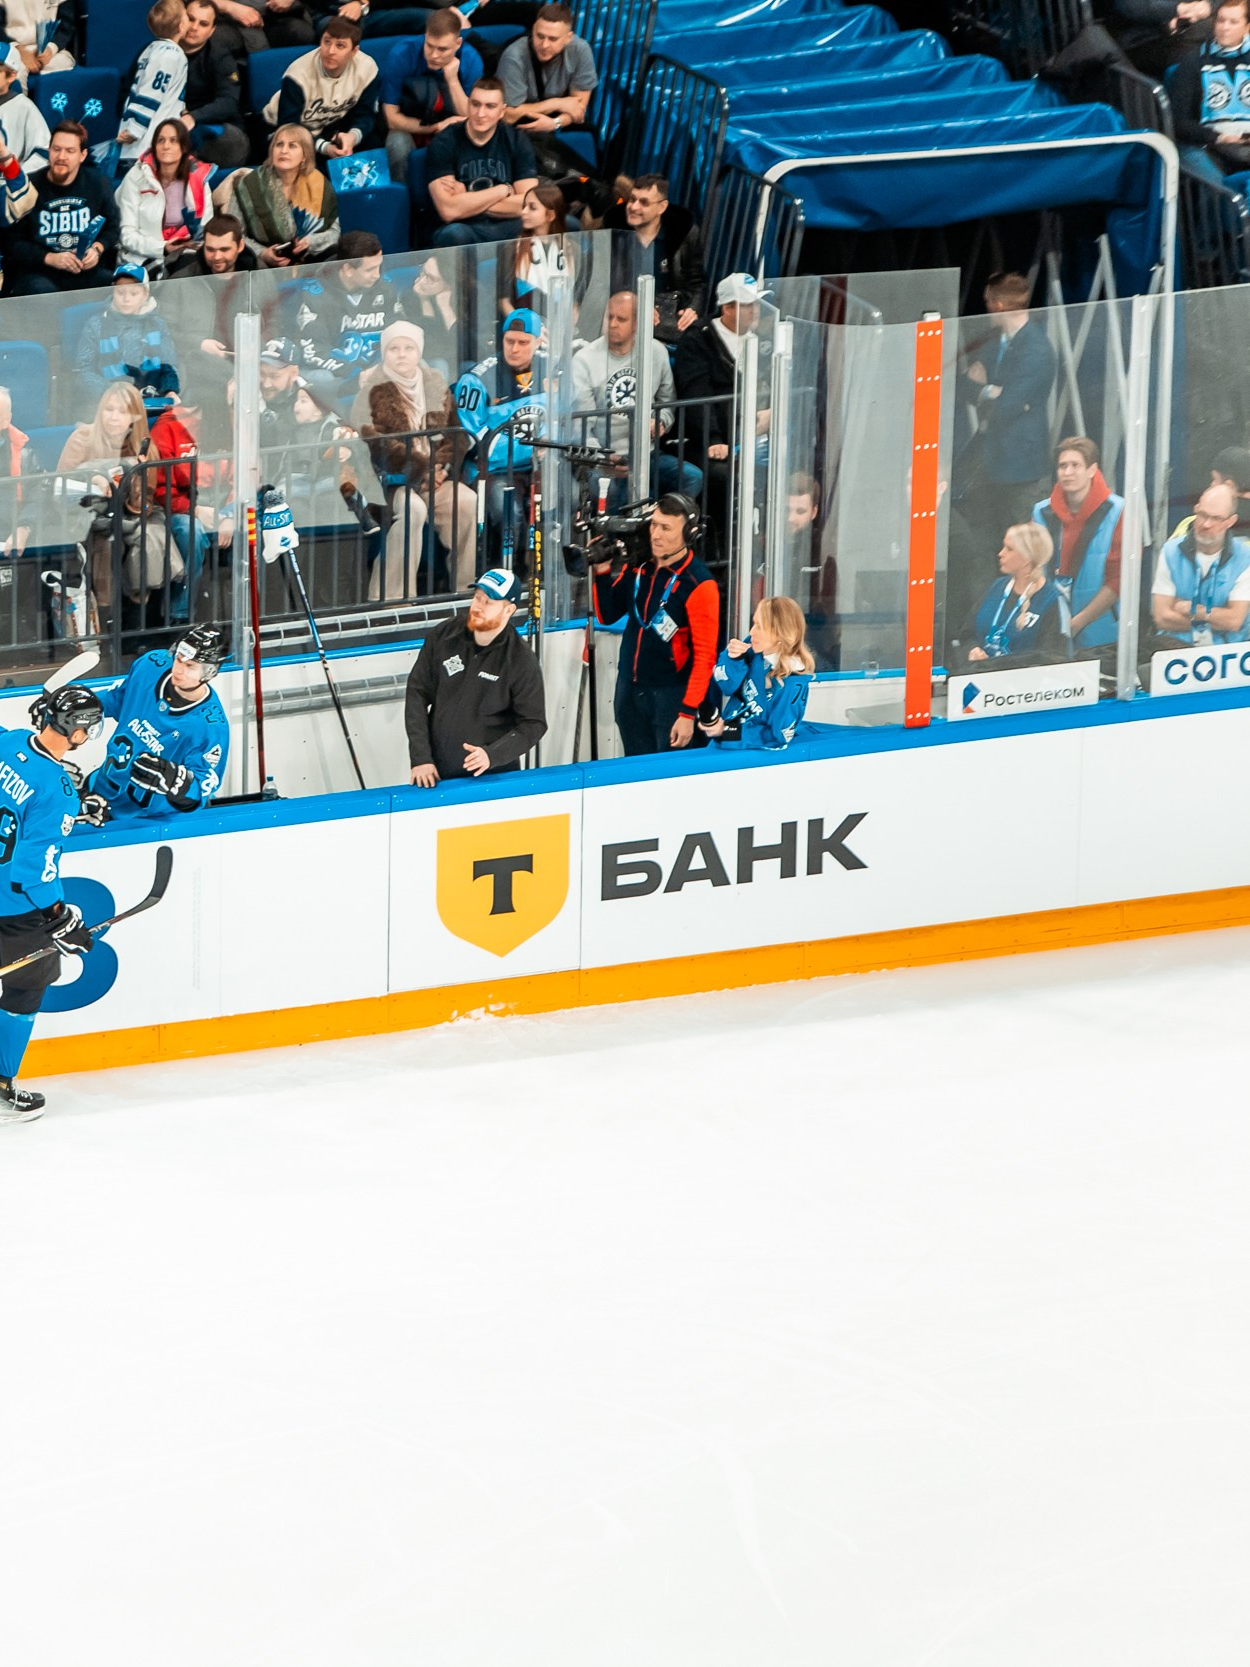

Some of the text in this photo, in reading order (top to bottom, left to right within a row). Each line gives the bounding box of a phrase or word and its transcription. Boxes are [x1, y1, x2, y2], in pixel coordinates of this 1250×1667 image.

[152, 70, 172, 93] 85
[39, 206, 91, 236] SIBIR
[457, 384, 482, 412] 80
[984, 685, 1085, 708] Ростелеком
[600, 811, 870, 902] БАНК
